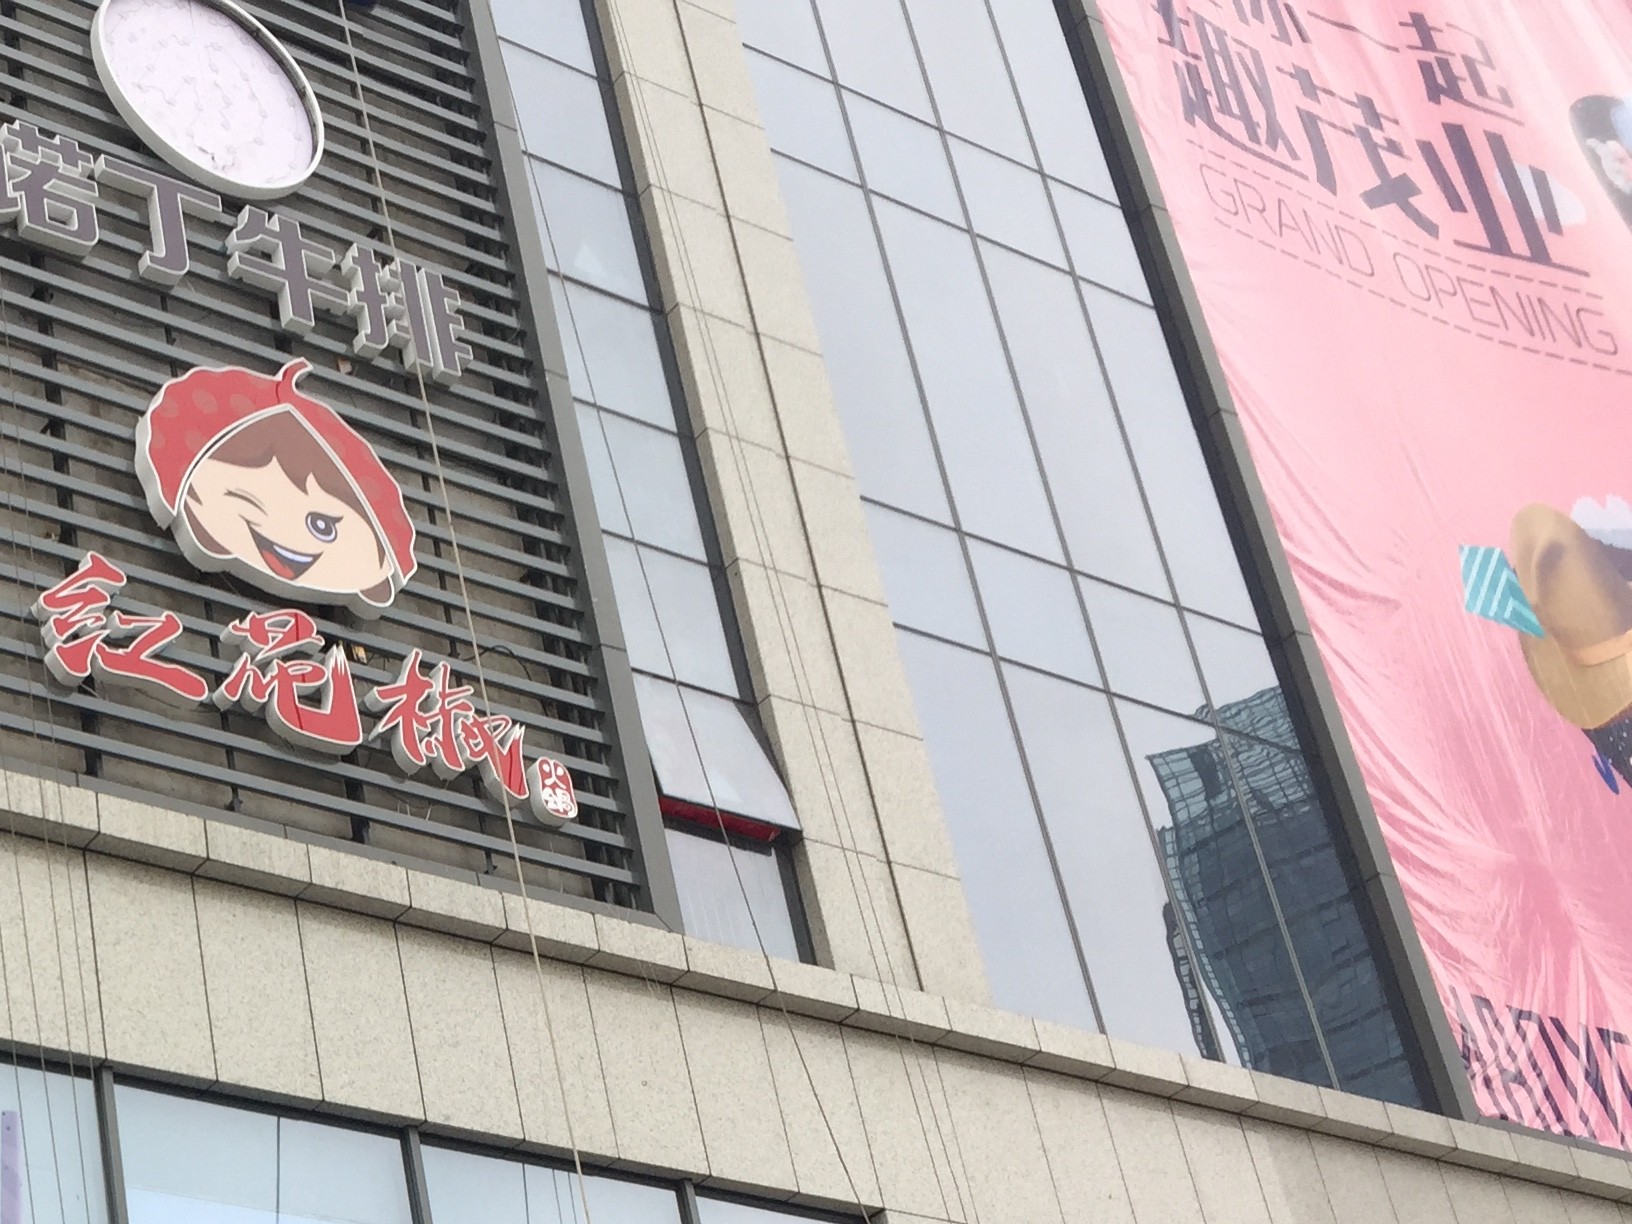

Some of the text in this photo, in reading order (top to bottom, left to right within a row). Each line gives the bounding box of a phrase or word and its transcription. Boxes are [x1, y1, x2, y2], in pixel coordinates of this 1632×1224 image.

[1199, 163, 1619, 355] GRAND OPENING
[36, 551, 529, 800] 红花椒
